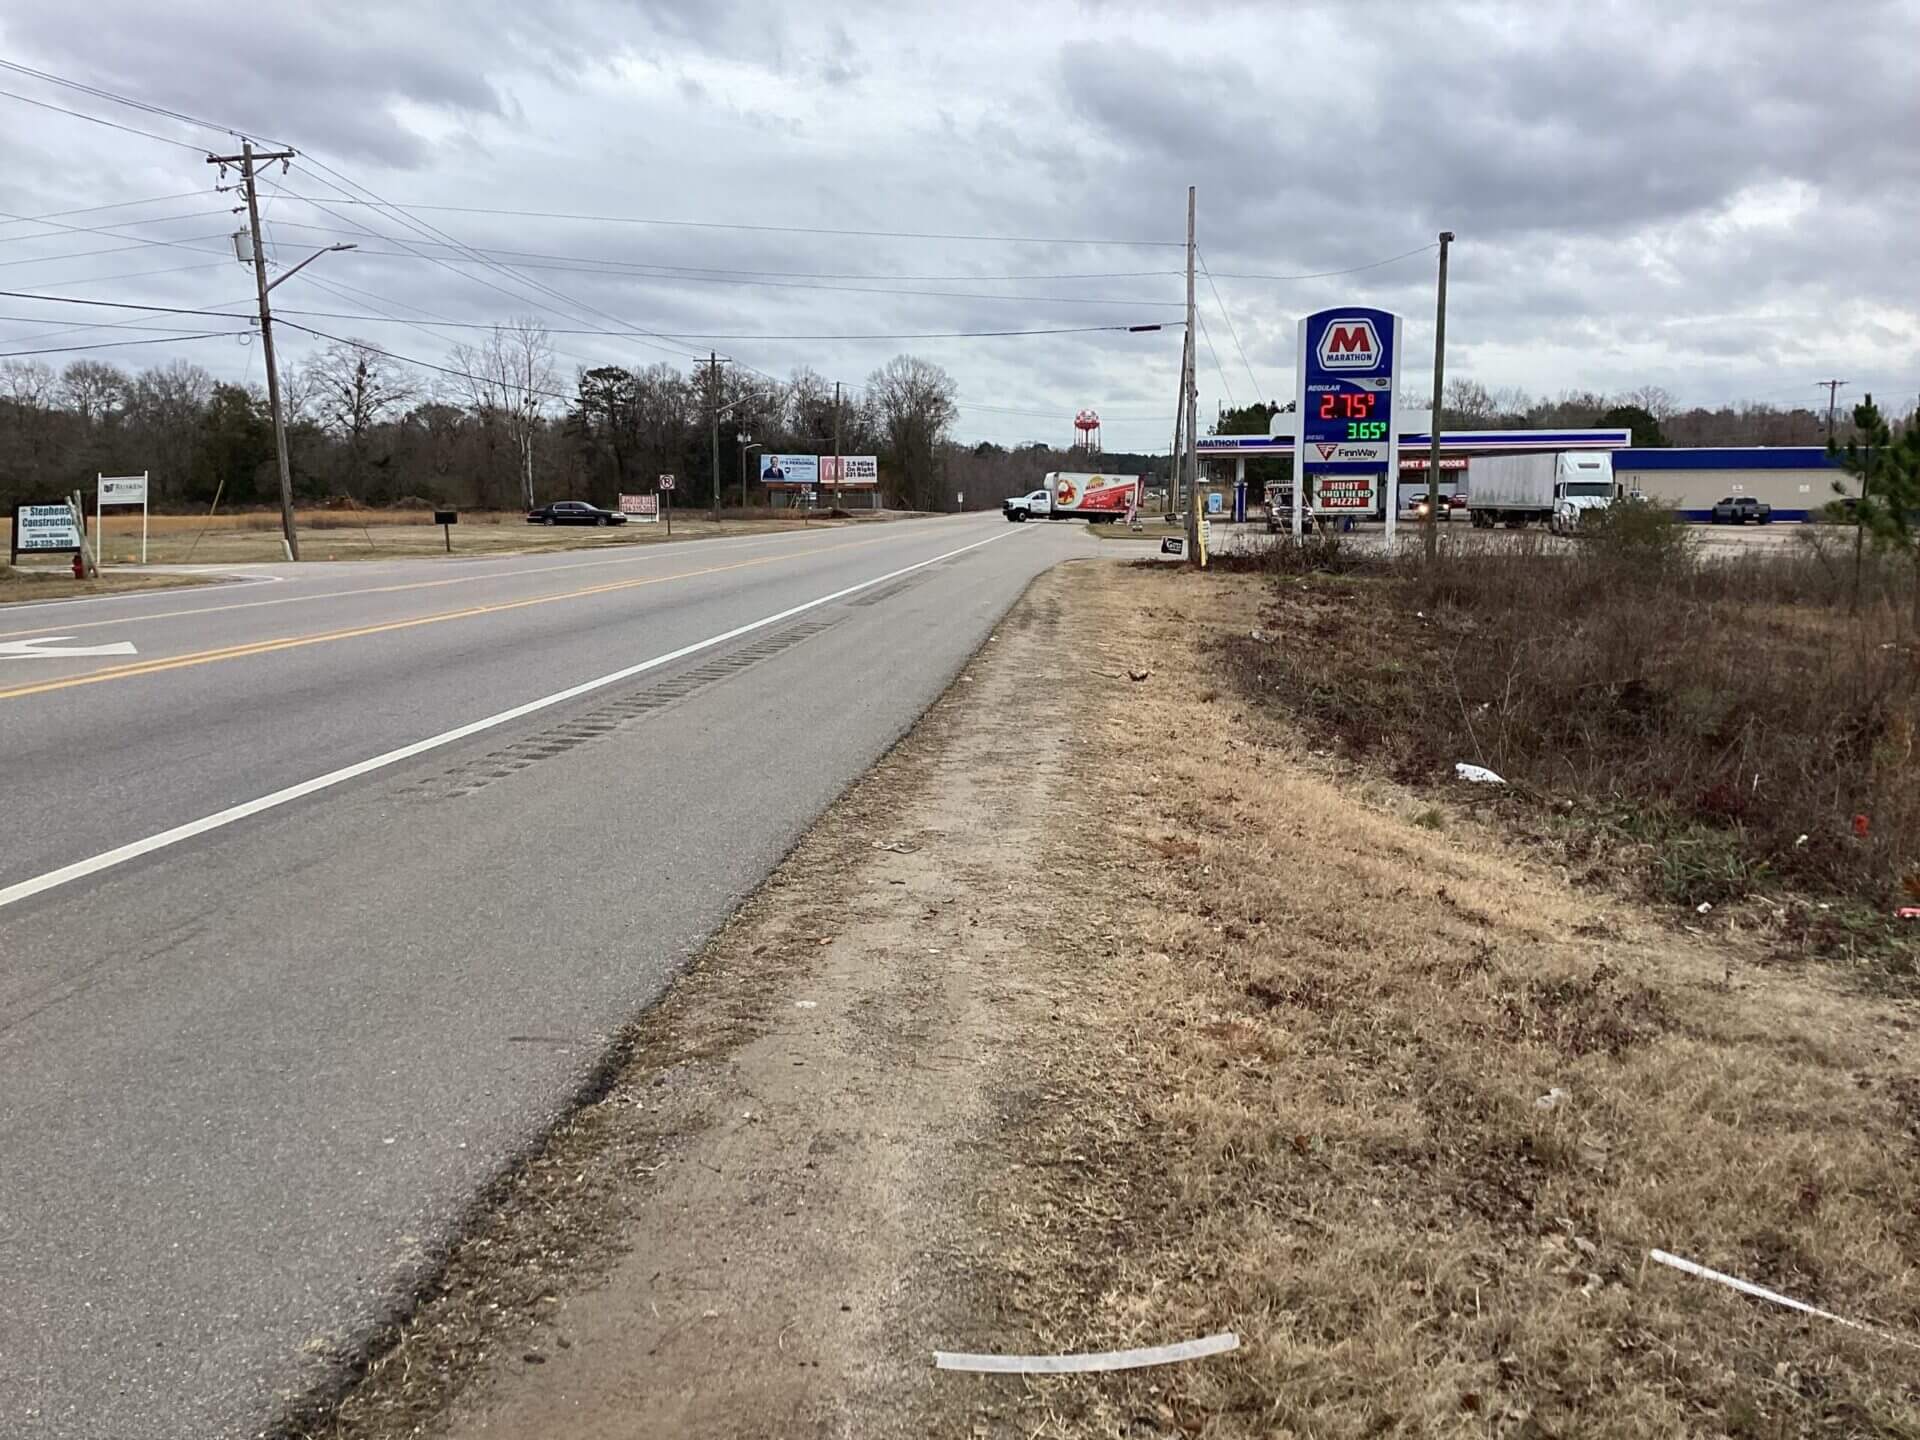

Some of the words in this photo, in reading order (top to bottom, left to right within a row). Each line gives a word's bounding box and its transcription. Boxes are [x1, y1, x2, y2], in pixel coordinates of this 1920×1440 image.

[1329, 327, 1371, 352] M
[1326, 353, 1372, 361] MARATHON
[1197, 439, 1238, 447] ARATHON
[1338, 449, 1378, 458] FinnWay
[1320, 490, 1371, 498] BROTHERS
[1330, 498, 1360, 506] PIZZA
[30, 506, 71, 516] Stephens
[22, 517, 73, 527] Constructio
